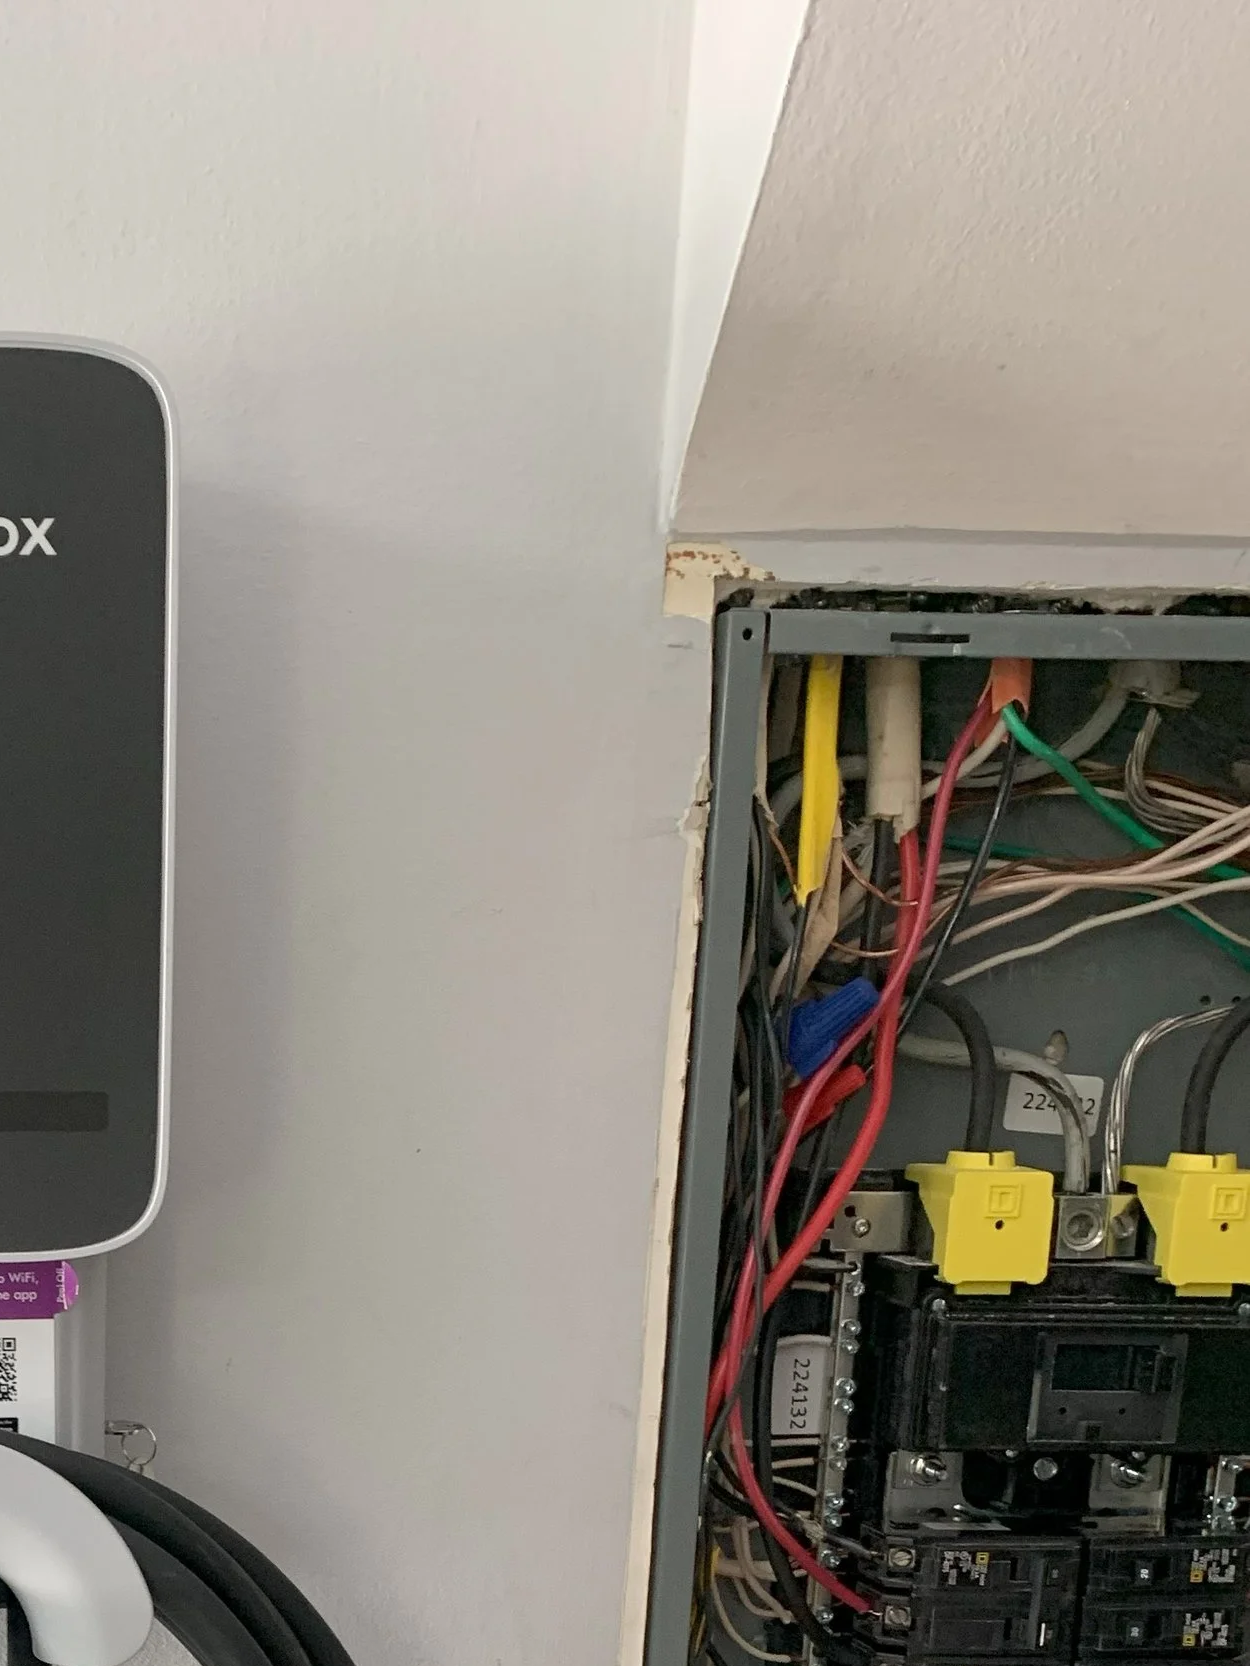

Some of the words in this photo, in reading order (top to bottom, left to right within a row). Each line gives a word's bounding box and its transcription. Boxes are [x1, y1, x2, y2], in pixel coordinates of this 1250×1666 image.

[8, 1271, 40, 1286] WiFi,
[13, 1290, 38, 1302] app
[790, 1358, 811, 1430] 224132
